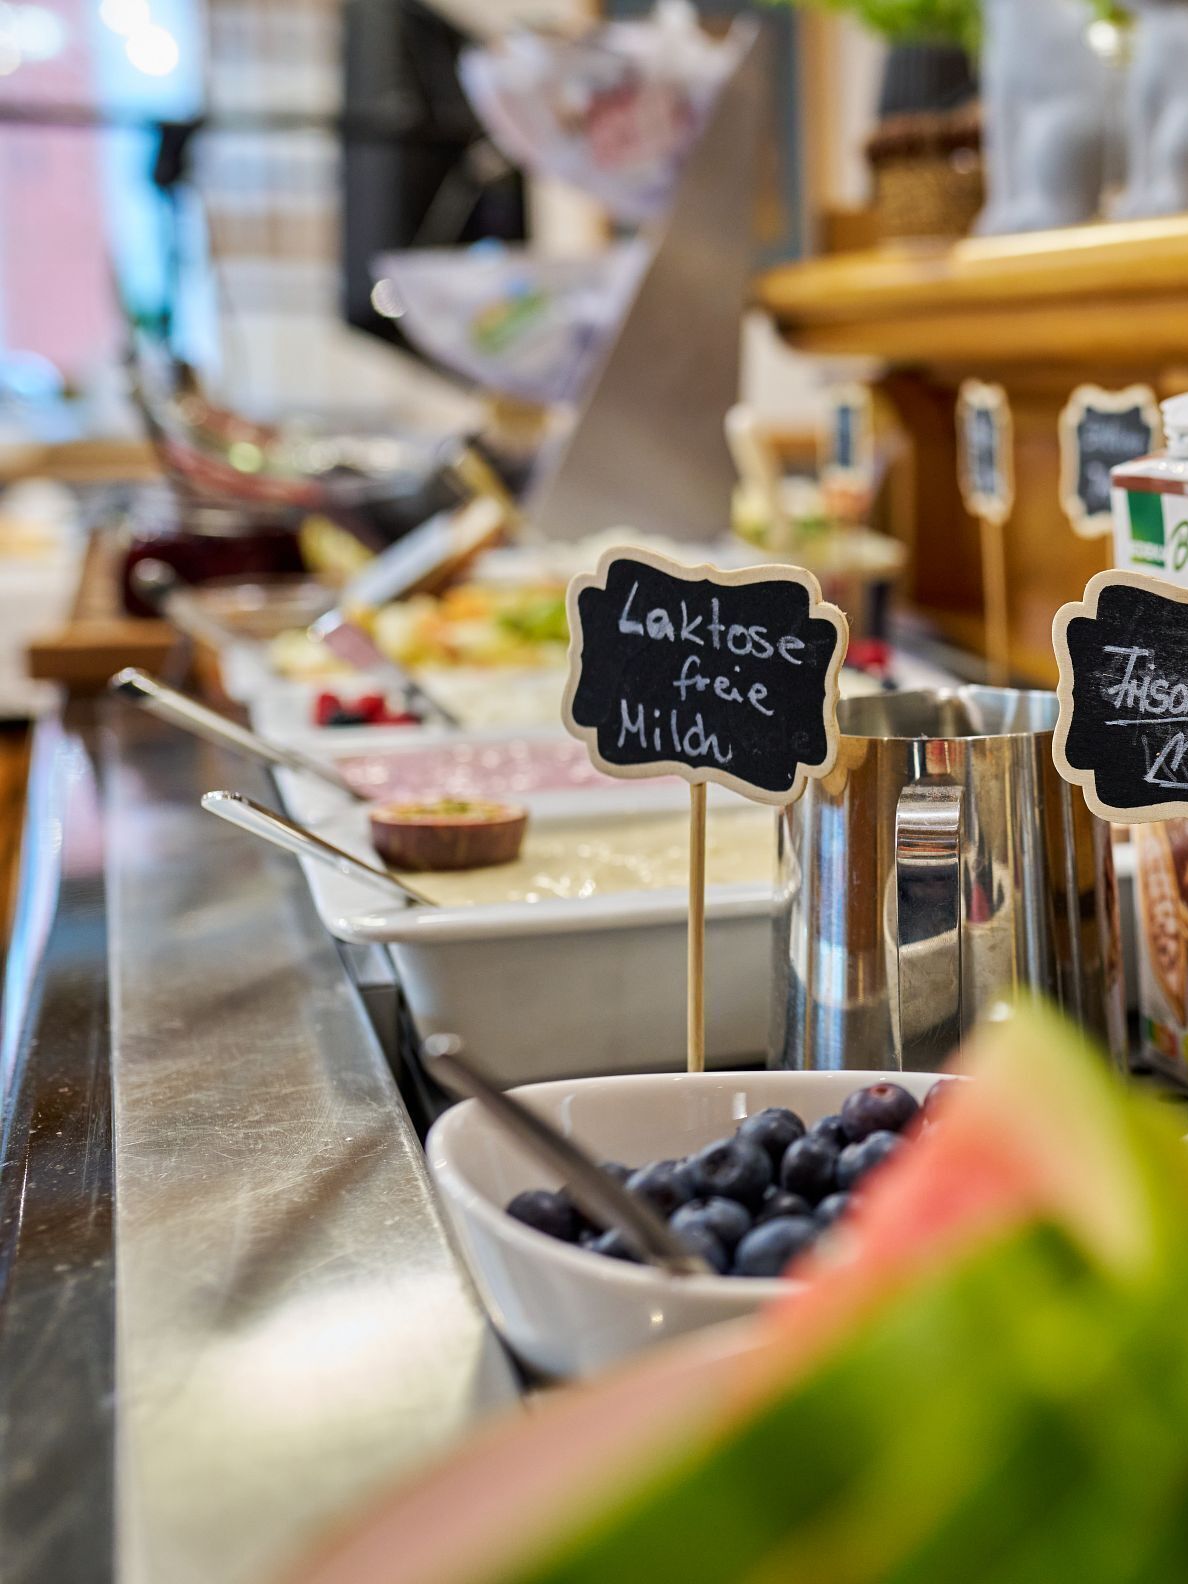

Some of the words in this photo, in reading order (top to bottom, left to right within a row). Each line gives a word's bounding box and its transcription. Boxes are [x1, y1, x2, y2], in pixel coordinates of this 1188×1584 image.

[617, 580, 806, 665] Laktose
[672, 655, 775, 717] freie
[617, 698, 733, 764] Milch
